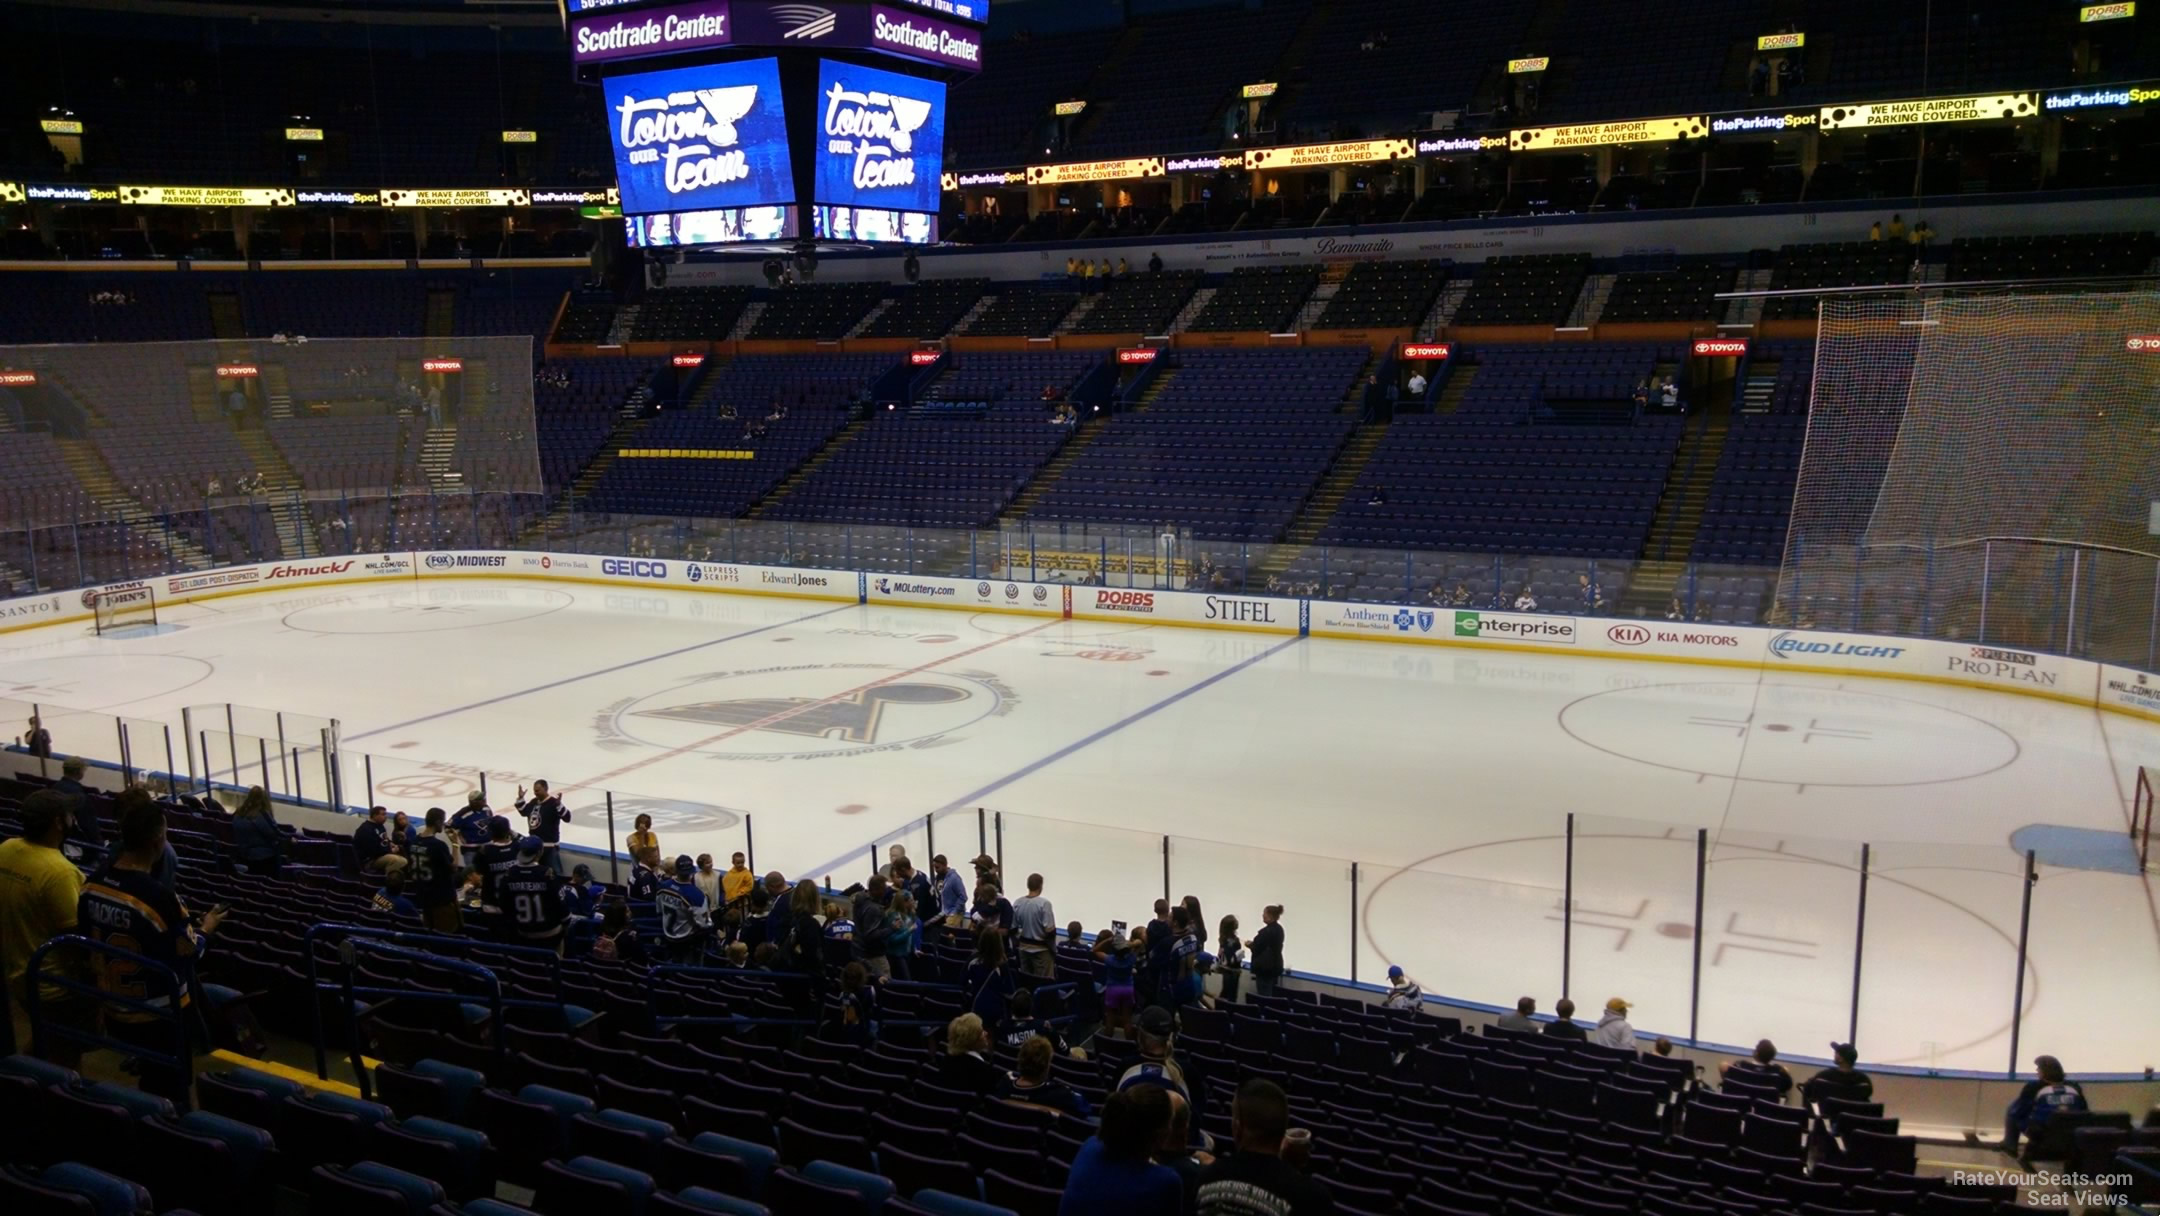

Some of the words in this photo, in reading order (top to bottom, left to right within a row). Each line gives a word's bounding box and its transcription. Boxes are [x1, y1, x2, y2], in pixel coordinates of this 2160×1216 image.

[2087, 4, 2129, 16] DOBBS
[577, 18, 662, 53] Scottrade
[874, 13, 938, 52] Scottrade
[1764, 35, 1799, 45] DOBBS
[1514, 59, 1545, 69] DOBBS
[1871, 106, 1888, 114] WE
[1891, 103, 1922, 113] HAVE
[1926, 100, 1977, 111] AIRPORT
[1713, 114, 1816, 131] theParkingSpot
[1867, 115, 1918, 124] PARKING
[1556, 128, 1571, 137] WE
[1573, 127, 1600, 135] HAVE
[1603, 122, 1647, 132] AIRPORT
[1419, 136, 1507, 152] theParkingSpot
[1553, 137, 1597, 146] PARKING
[1292, 148, 1305, 156] WE
[1307, 147, 1330, 155] HAVE
[1333, 143, 1371, 153] AIRPORT
[1094, 162, 1126, 170] AIRPORT
[1167, 156, 1243, 171] theParkingSpot
[1290, 155, 1328, 165] PARKING
[959, 172, 1025, 185] theParkingSpot
[1057, 172, 1090, 181] PARKING
[29, 188, 118, 201] theParkingSpot
[161, 196, 202, 204] PARKING
[298, 192, 378, 204] theParkingSpot
[533, 193, 605, 203] theParkingSpot
[1313, 237, 1394, 255] Bommarito
[431, 555, 449, 564] FOX
[456, 556, 507, 567] MIDWEST
[553, 560, 572, 568] Harris
[573, 561, 589, 569] Bank
[264, 560, 356, 580] Schnucks
[601, 559, 667, 578] GEICO
[704, 566, 738, 575] EXPRESS
[190, 578, 208, 587] LOUIS
[209, 572, 260, 584] POST-DISPATCH
[704, 573, 739, 583] SCRIPTS
[893, 582, 955, 597] MOLottery.com
[106, 591, 146, 607] JOHN'S
[1097, 590, 1154, 607] DOBBS
[1205, 596, 1276, 623] STIFEL
[1301, 600, 1309, 628] Reebok
[1343, 608, 1389, 621] Anthem
[1357, 622, 1390, 630] BlueShield
[1458, 618, 1573, 636] enterprise
[1615, 628, 1644, 641] KIA
[1657, 632, 1679, 642] KIA
[1683, 634, 1738, 647] MOTORS
[1778, 639, 1830, 655] BUD
[1832, 642, 1906, 658] LIGHT
[1984, 649, 2034, 665] PURINA
[1947, 657, 1991, 676] PRO
[1995, 662, 2057, 685] PLAN
[791, 744, 905, 760] Scottrade
[514, 894, 546, 924] 91
[1007, 1028, 1036, 1045] MASON
